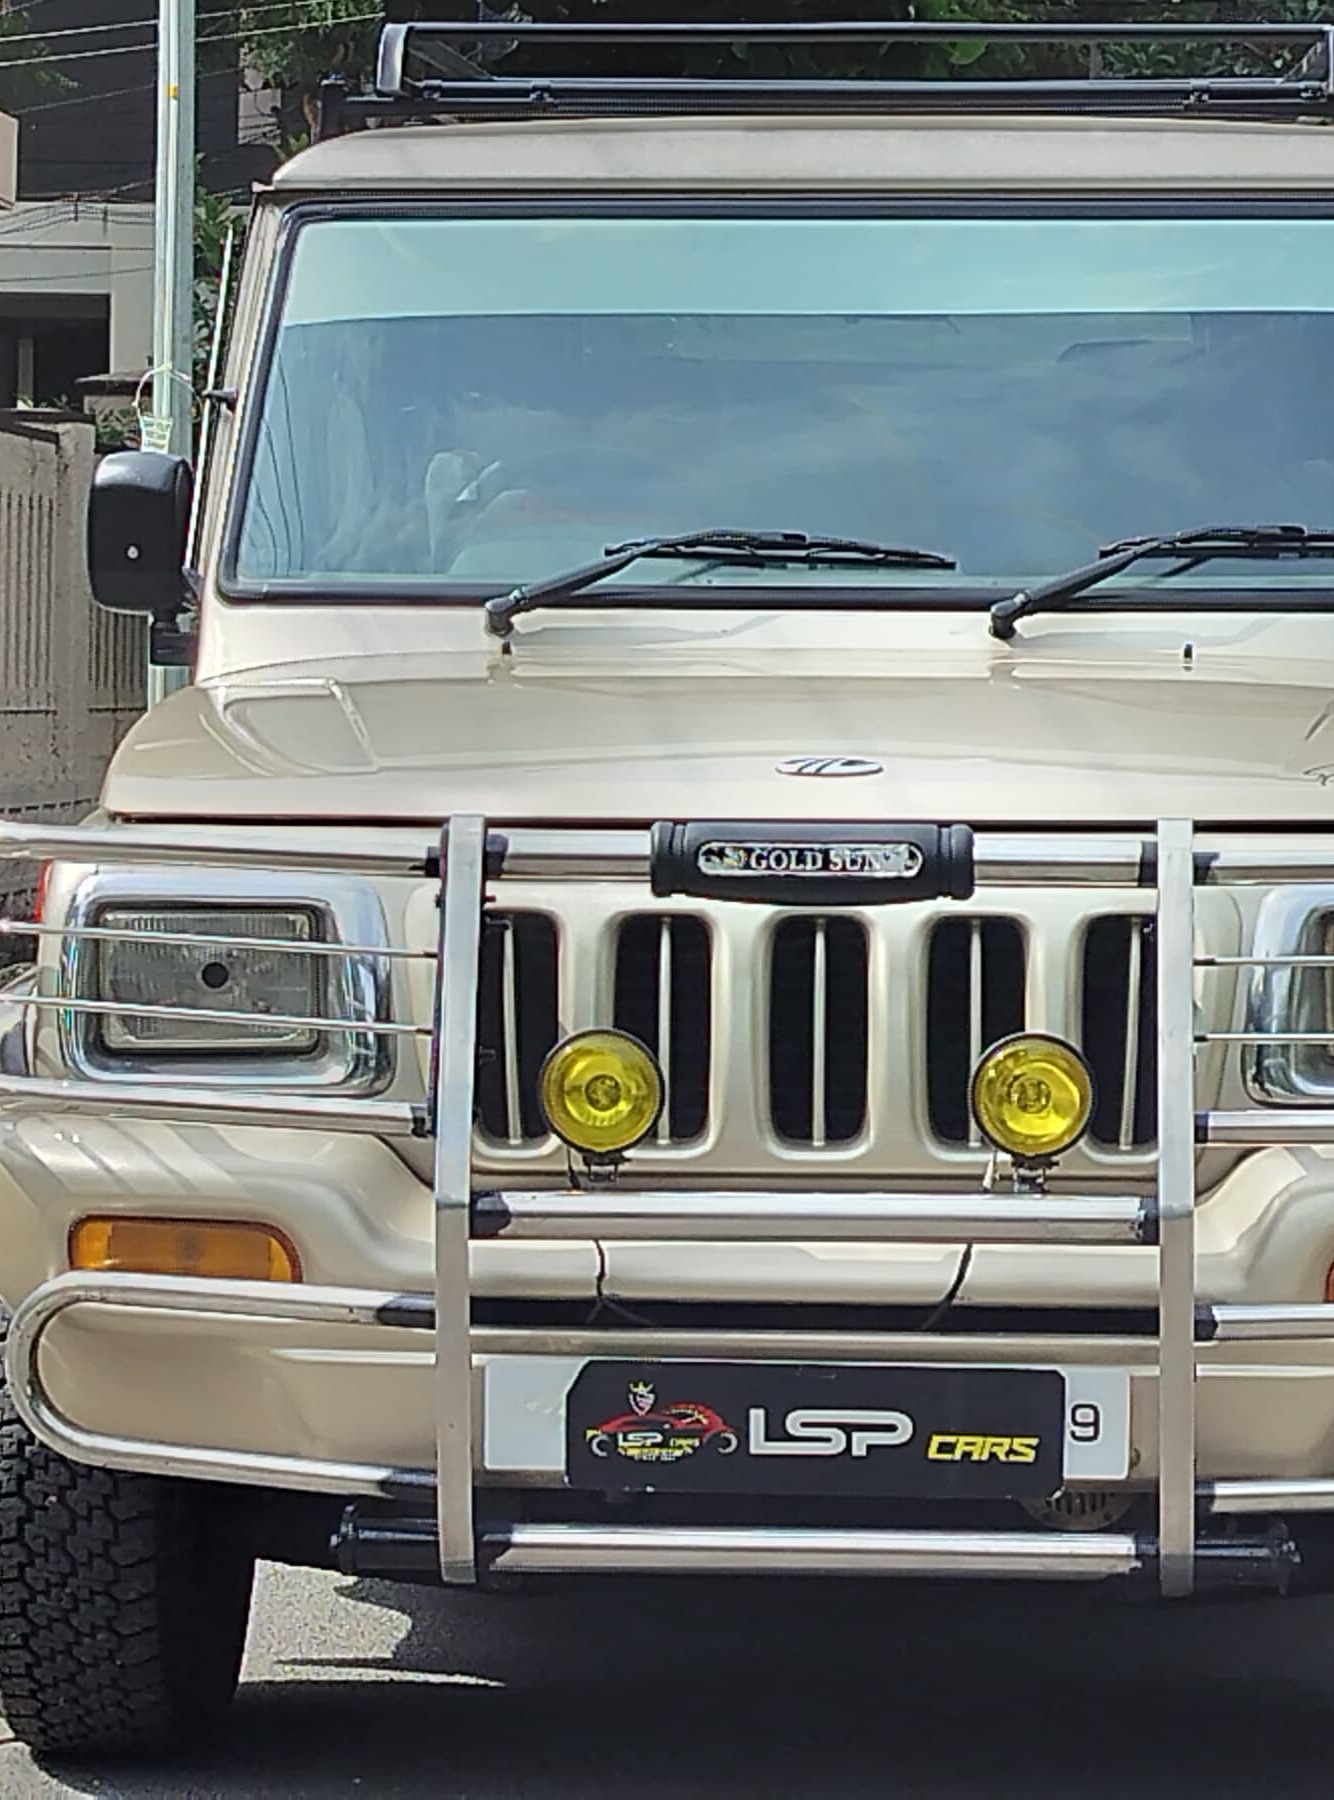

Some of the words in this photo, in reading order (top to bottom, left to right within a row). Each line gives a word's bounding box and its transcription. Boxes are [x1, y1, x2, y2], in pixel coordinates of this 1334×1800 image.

[749, 849, 823, 871] GOLD
[828, 849, 882, 871] SUN
[749, 1407, 913, 1457] LSP
[927, 1434, 1040, 1463] CARS
[1069, 1402, 1101, 1443] 9
